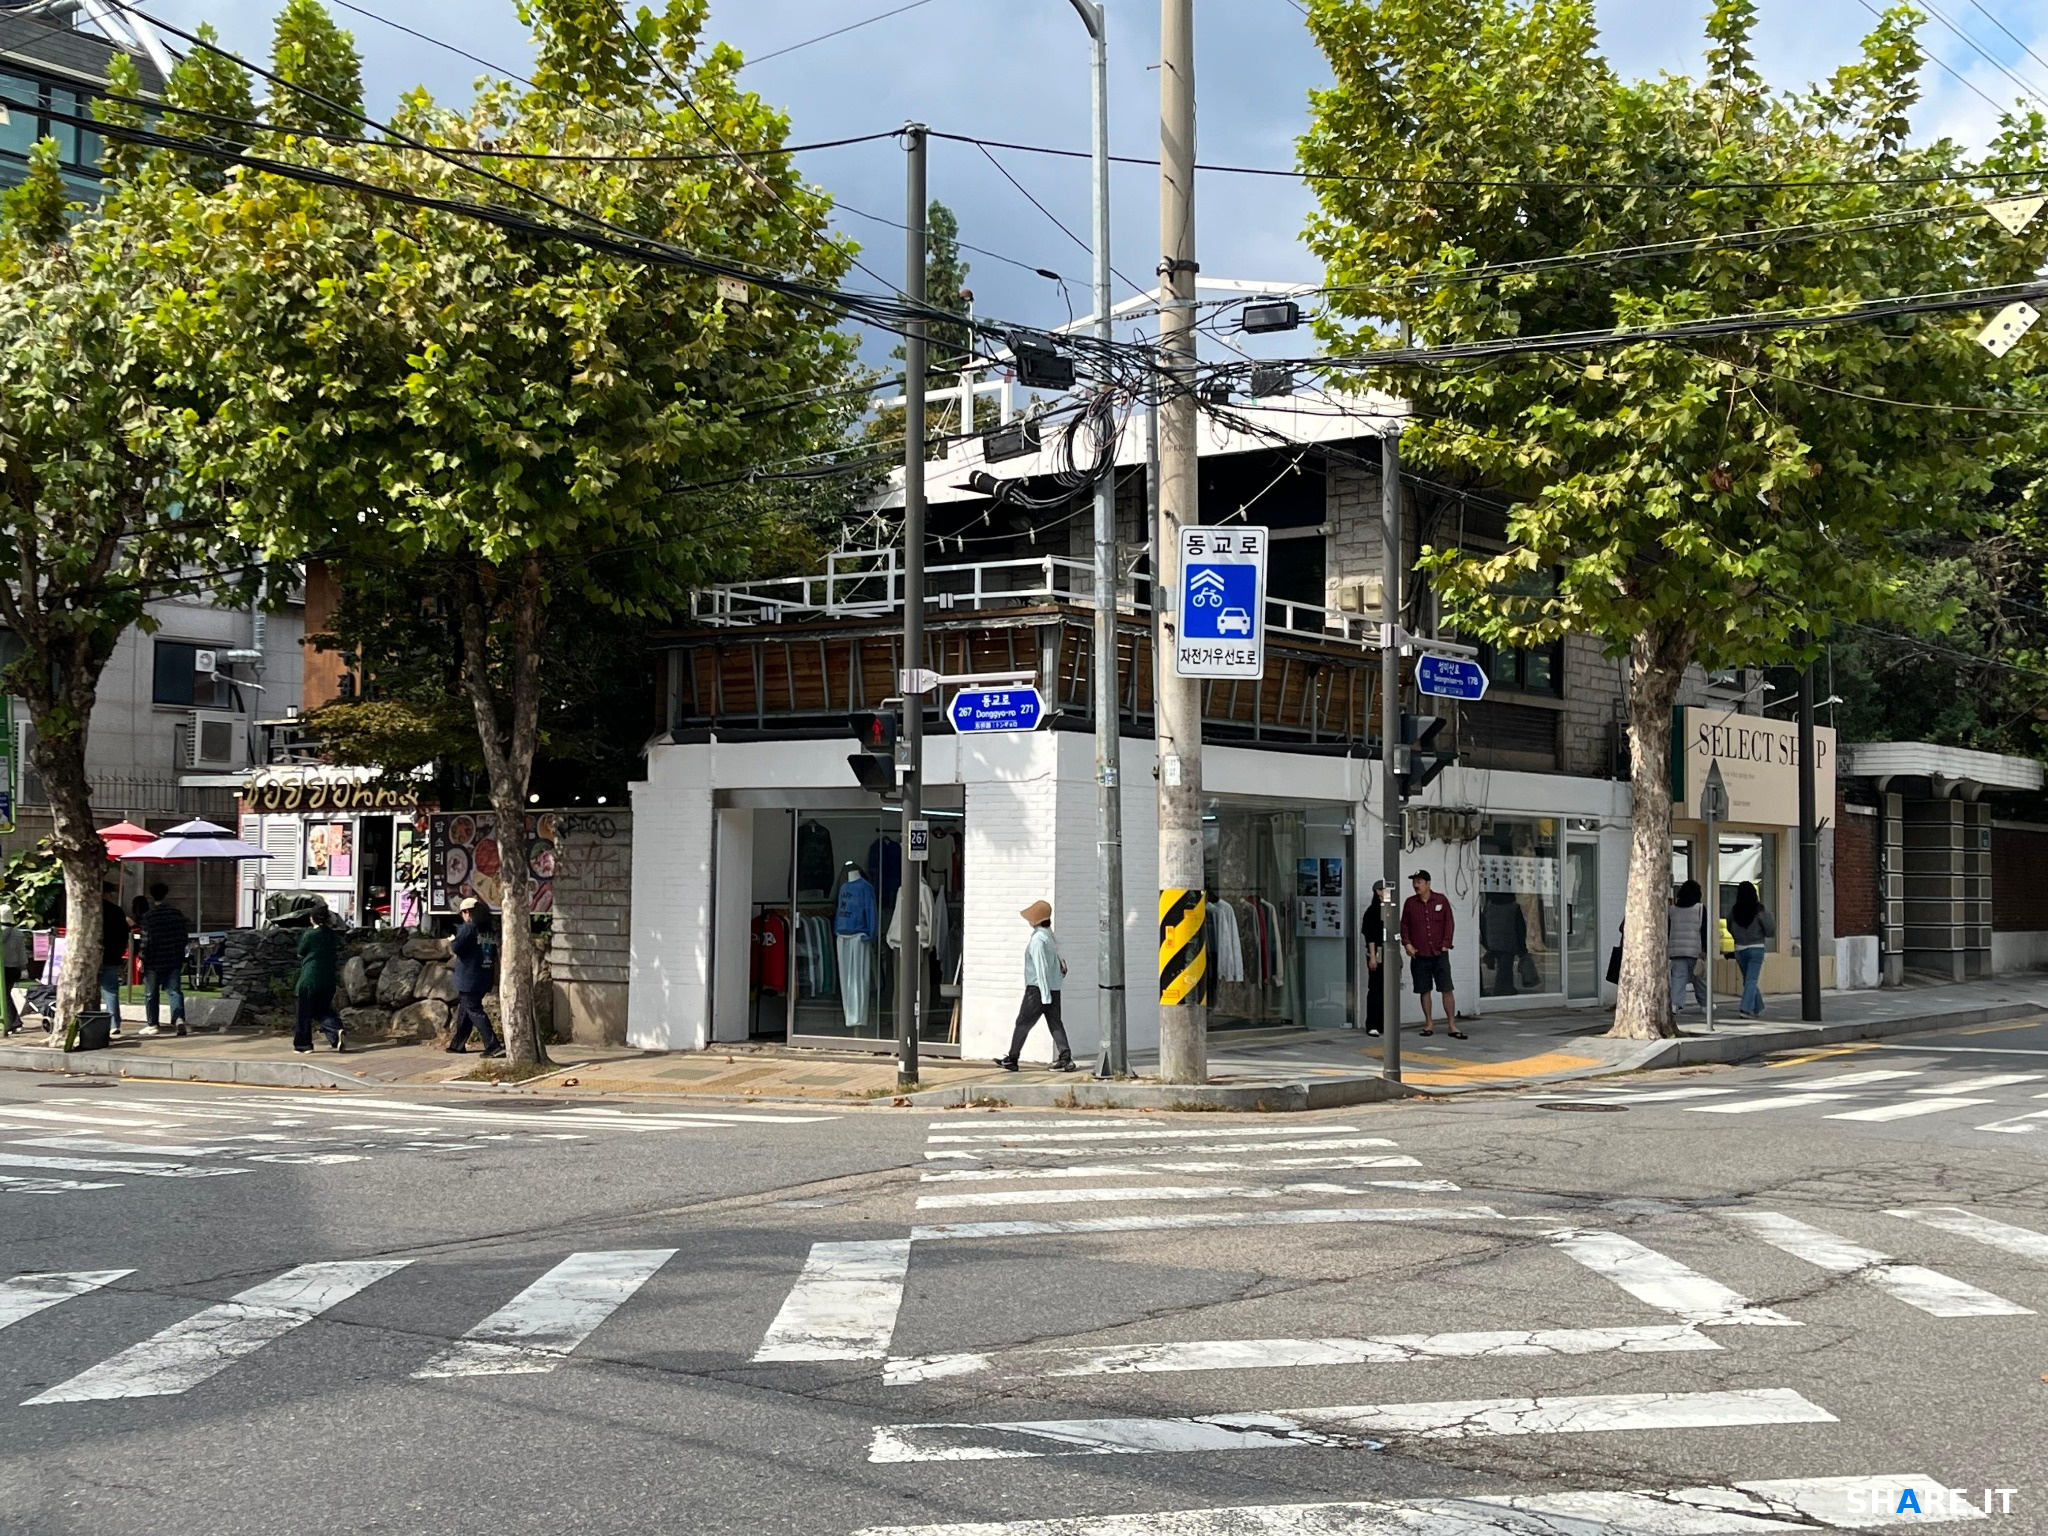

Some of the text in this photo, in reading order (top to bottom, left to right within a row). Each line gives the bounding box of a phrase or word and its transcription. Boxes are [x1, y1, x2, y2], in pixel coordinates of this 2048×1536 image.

[1187, 535, 1259, 555] 동교로
[1180, 648, 1257, 666] 자전거우선도로
[981, 694, 1011, 708] 동교로
[958, 704, 1034, 719] 267 Donggyo-ro 271
[1699, 722, 1827, 769] SELECT SHP
[911, 832, 927, 844] 267
